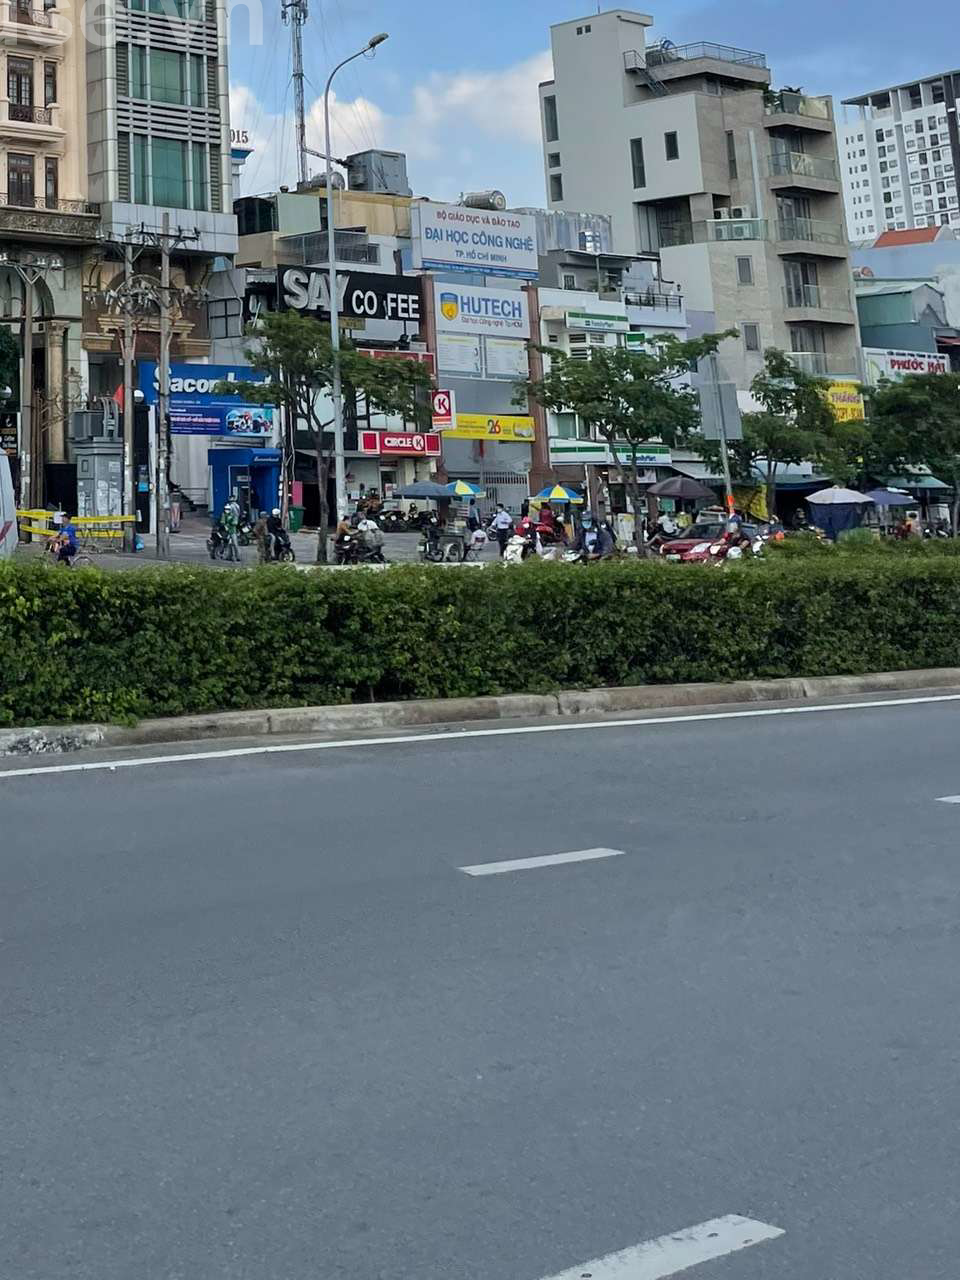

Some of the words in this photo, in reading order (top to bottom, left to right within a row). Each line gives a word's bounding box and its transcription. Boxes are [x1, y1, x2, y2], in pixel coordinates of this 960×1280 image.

[447, 210, 465, 222] GIÁO
[465, 215, 480, 225] DỤC
[481, 215, 491, 225] VÀ
[425, 227, 443, 243] ĐẠI
[446, 230, 469, 246] HỌC
[471, 231, 503, 248] CÔNG
[282, 269, 350, 312] SAY
[460, 296, 522, 318] HUTECH
[384, 437, 413, 447] CIRCLE
